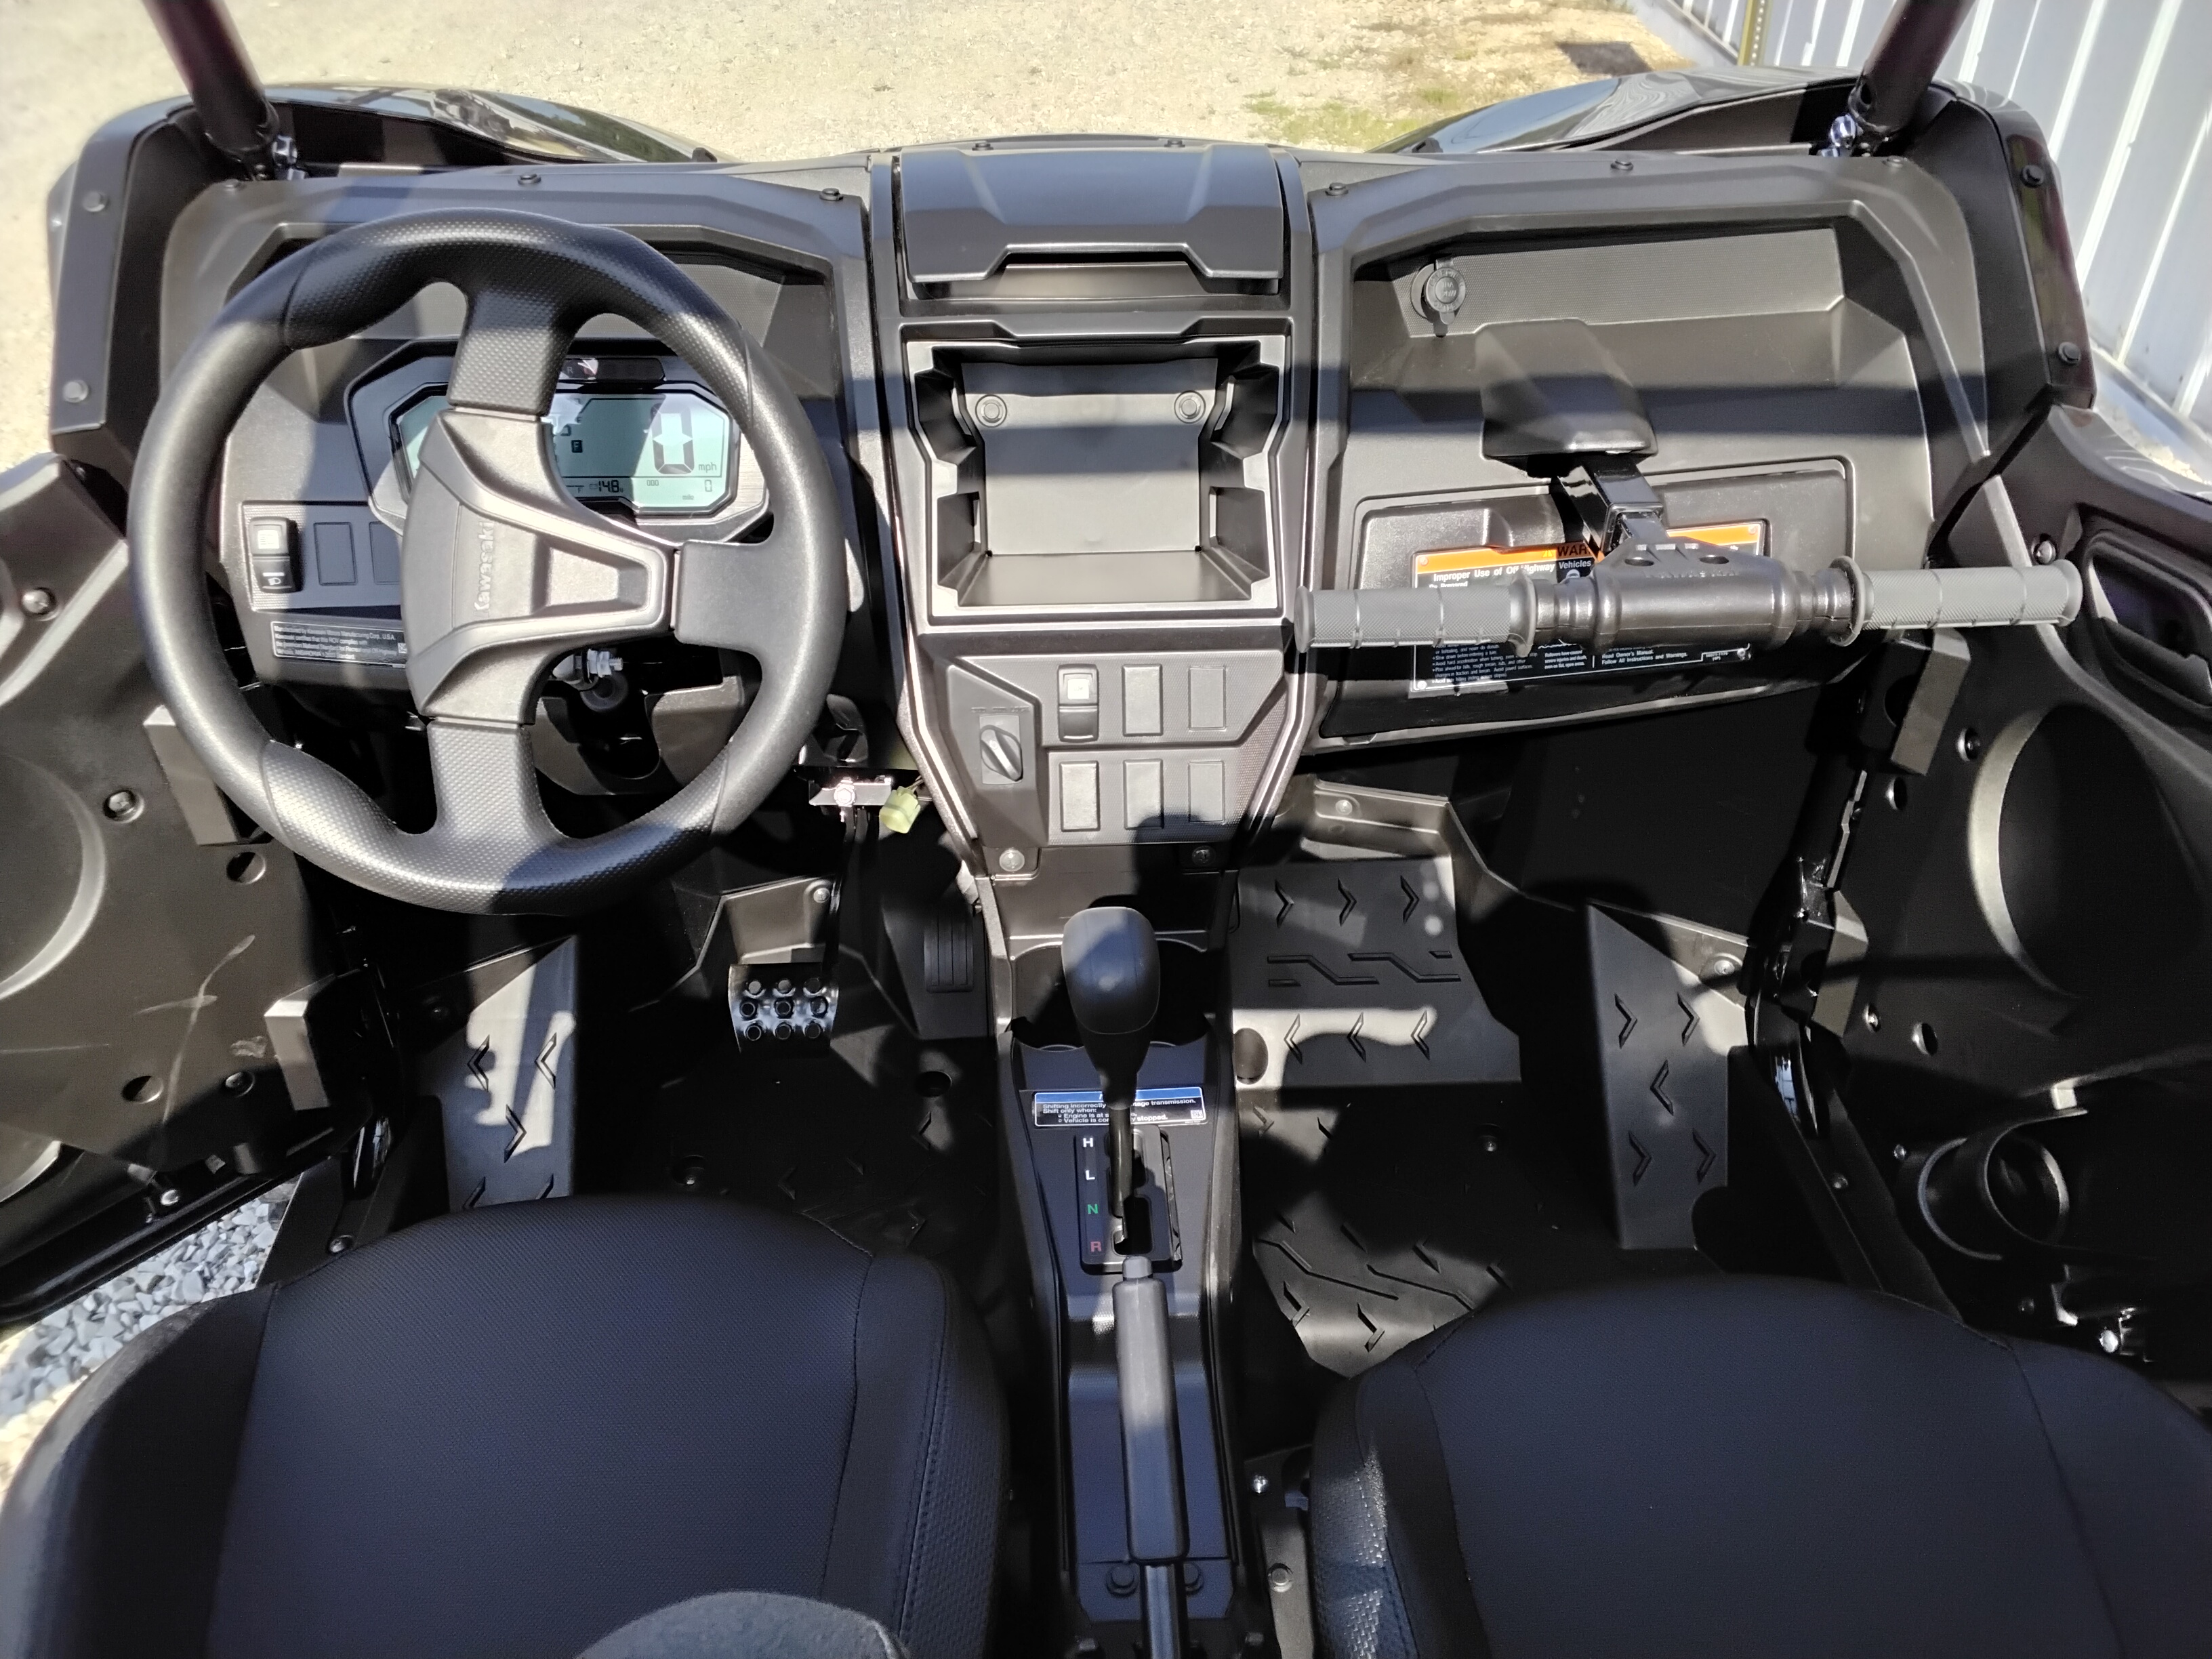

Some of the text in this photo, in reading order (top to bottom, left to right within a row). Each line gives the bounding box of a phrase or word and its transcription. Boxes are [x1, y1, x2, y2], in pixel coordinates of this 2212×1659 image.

[651, 403, 695, 474] 0
[698, 462, 717, 473] mph
[474, 521, 495, 618] Kawasaki
[1433, 571, 1471, 583] Improper
[1474, 569, 1490, 577] Use
[1493, 567, 1503, 576] of
[1559, 560, 1592, 569] Vehicles
[1136, 1113, 1168, 1122] stopped.
[1082, 1137, 1094, 1147] H
[1085, 1170, 1096, 1181] L
[1087, 1204, 1099, 1214] N
[1090, 1241, 1102, 1252] R
